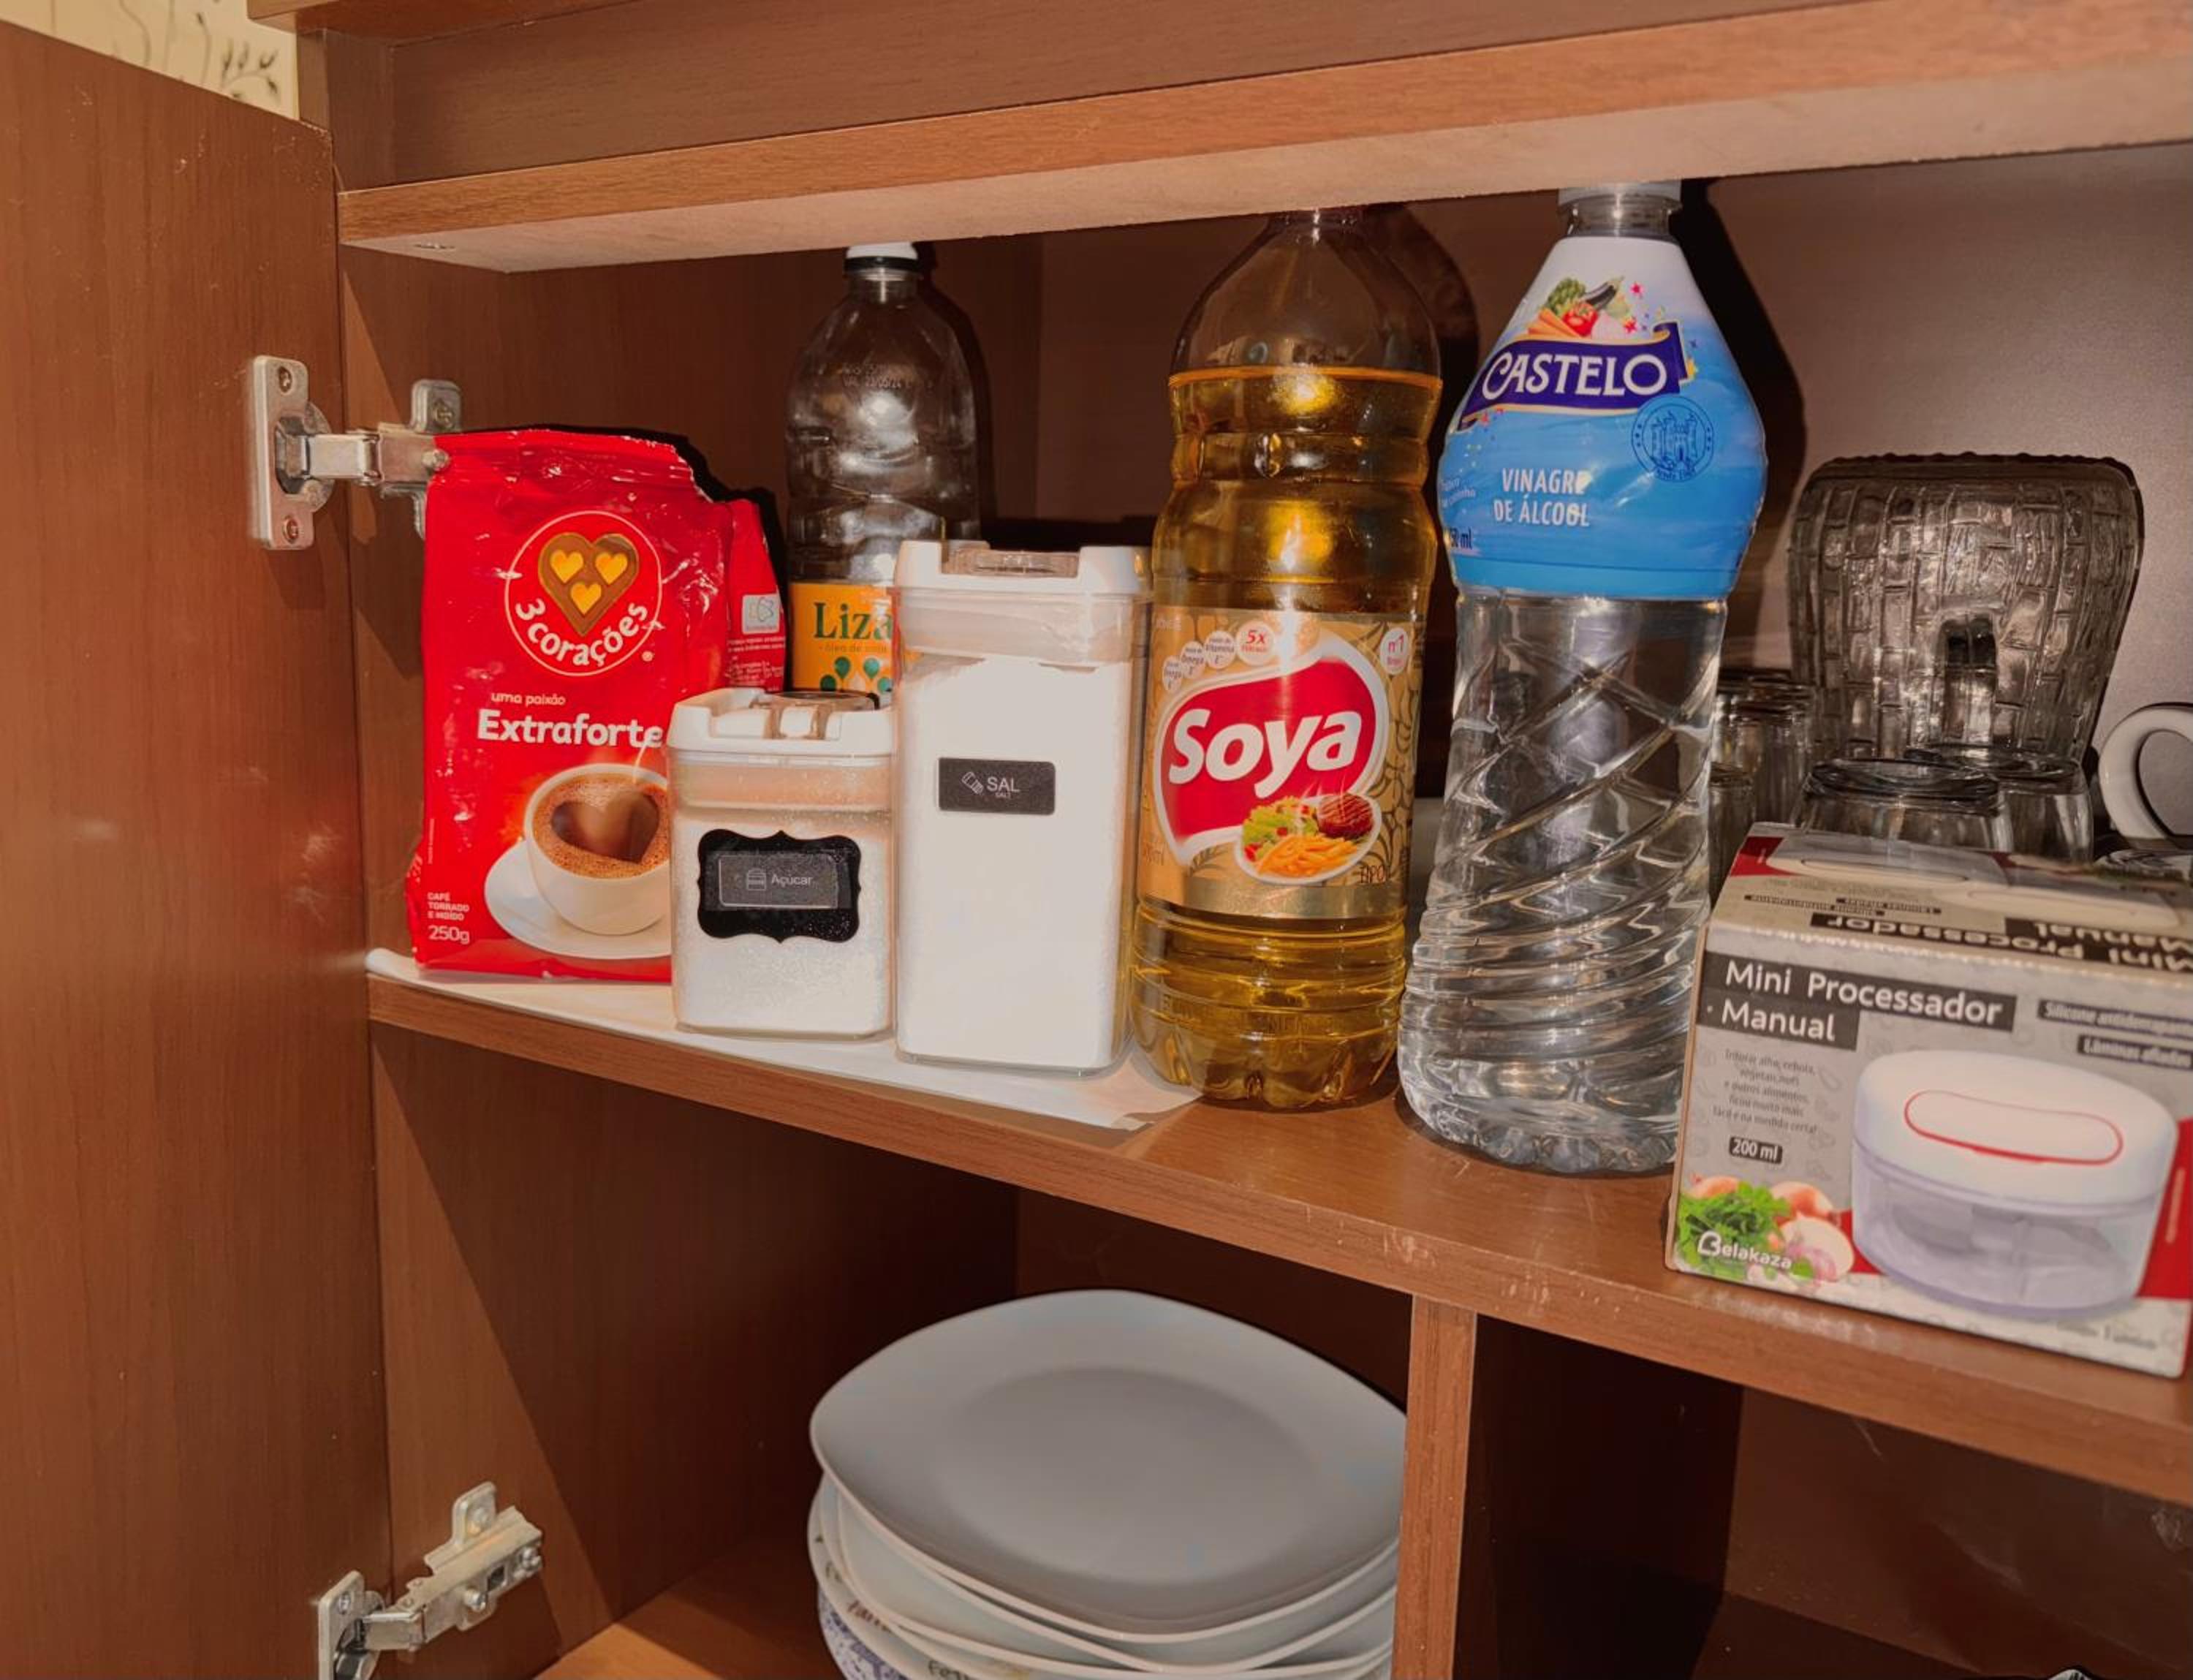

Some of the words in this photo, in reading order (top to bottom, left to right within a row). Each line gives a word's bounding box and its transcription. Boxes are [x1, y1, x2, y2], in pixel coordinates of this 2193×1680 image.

[1482, 352, 1667, 400] CASTELO
[1494, 499, 1512, 522] DE
[1519, 493, 1590, 527] ÁLCOOL
[515, 598, 545, 621] 3
[527, 602, 648, 667] corações
[1246, 629, 1265, 644] 5x
[491, 692, 523, 704] uma
[525, 693, 567, 706] paixão
[478, 708, 664, 748] Extraforte
[1170, 708, 1363, 799] Soya
[987, 776, 1020, 792] SAL
[771, 872, 812, 888] Açúcar
[427, 891, 451, 901] CAFÉ
[428, 901, 470, 912] TORRADO
[428, 911, 435, 919] E
[428, 924, 470, 945] 250g
[1828, 916, 2085, 959] Processador
[1725, 960, 1792, 995] Mini
[1808, 972, 2004, 1024] Processador
[1722, 998, 1836, 1041] Manual
[1732, 1138, 1758, 1157] 200
[1760, 1143, 1779, 1161] ml
